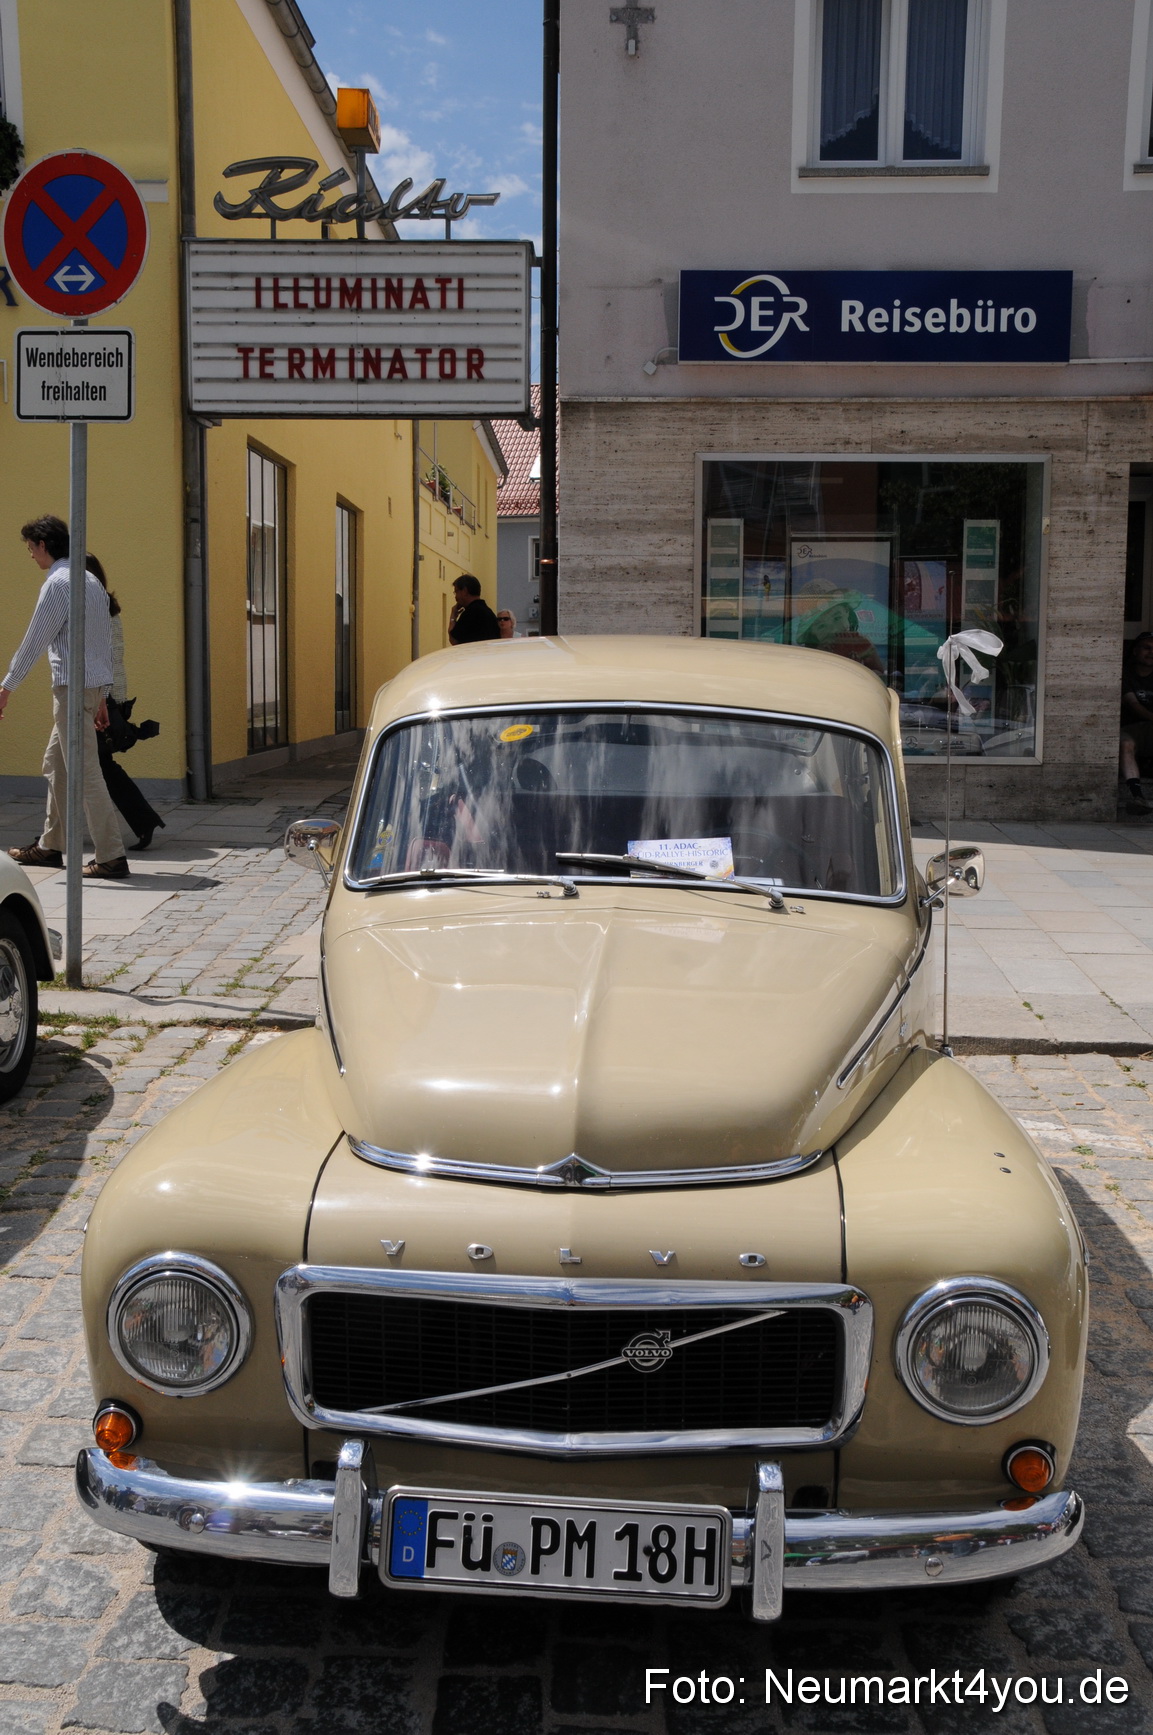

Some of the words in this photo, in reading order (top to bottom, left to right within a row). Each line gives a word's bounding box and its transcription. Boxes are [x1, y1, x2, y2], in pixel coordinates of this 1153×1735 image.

[213, 156, 500, 222] Rialto
[255, 277, 464, 310] ILLUMINATI
[840, 298, 1037, 335] Reisebüro
[25, 346, 124, 369] Wendebereich
[237, 347, 486, 380] TERMINATOR
[41, 381, 107, 402] freihalten
[380, 1239, 767, 1268] VOLVO
[625, 1349, 670, 1357] VOLVO
[402, 1546, 414, 1562] D
[426, 1510, 494, 1572] FÜ
[530, 1516, 597, 1579] PM
[612, 1522, 717, 1586] 18H
